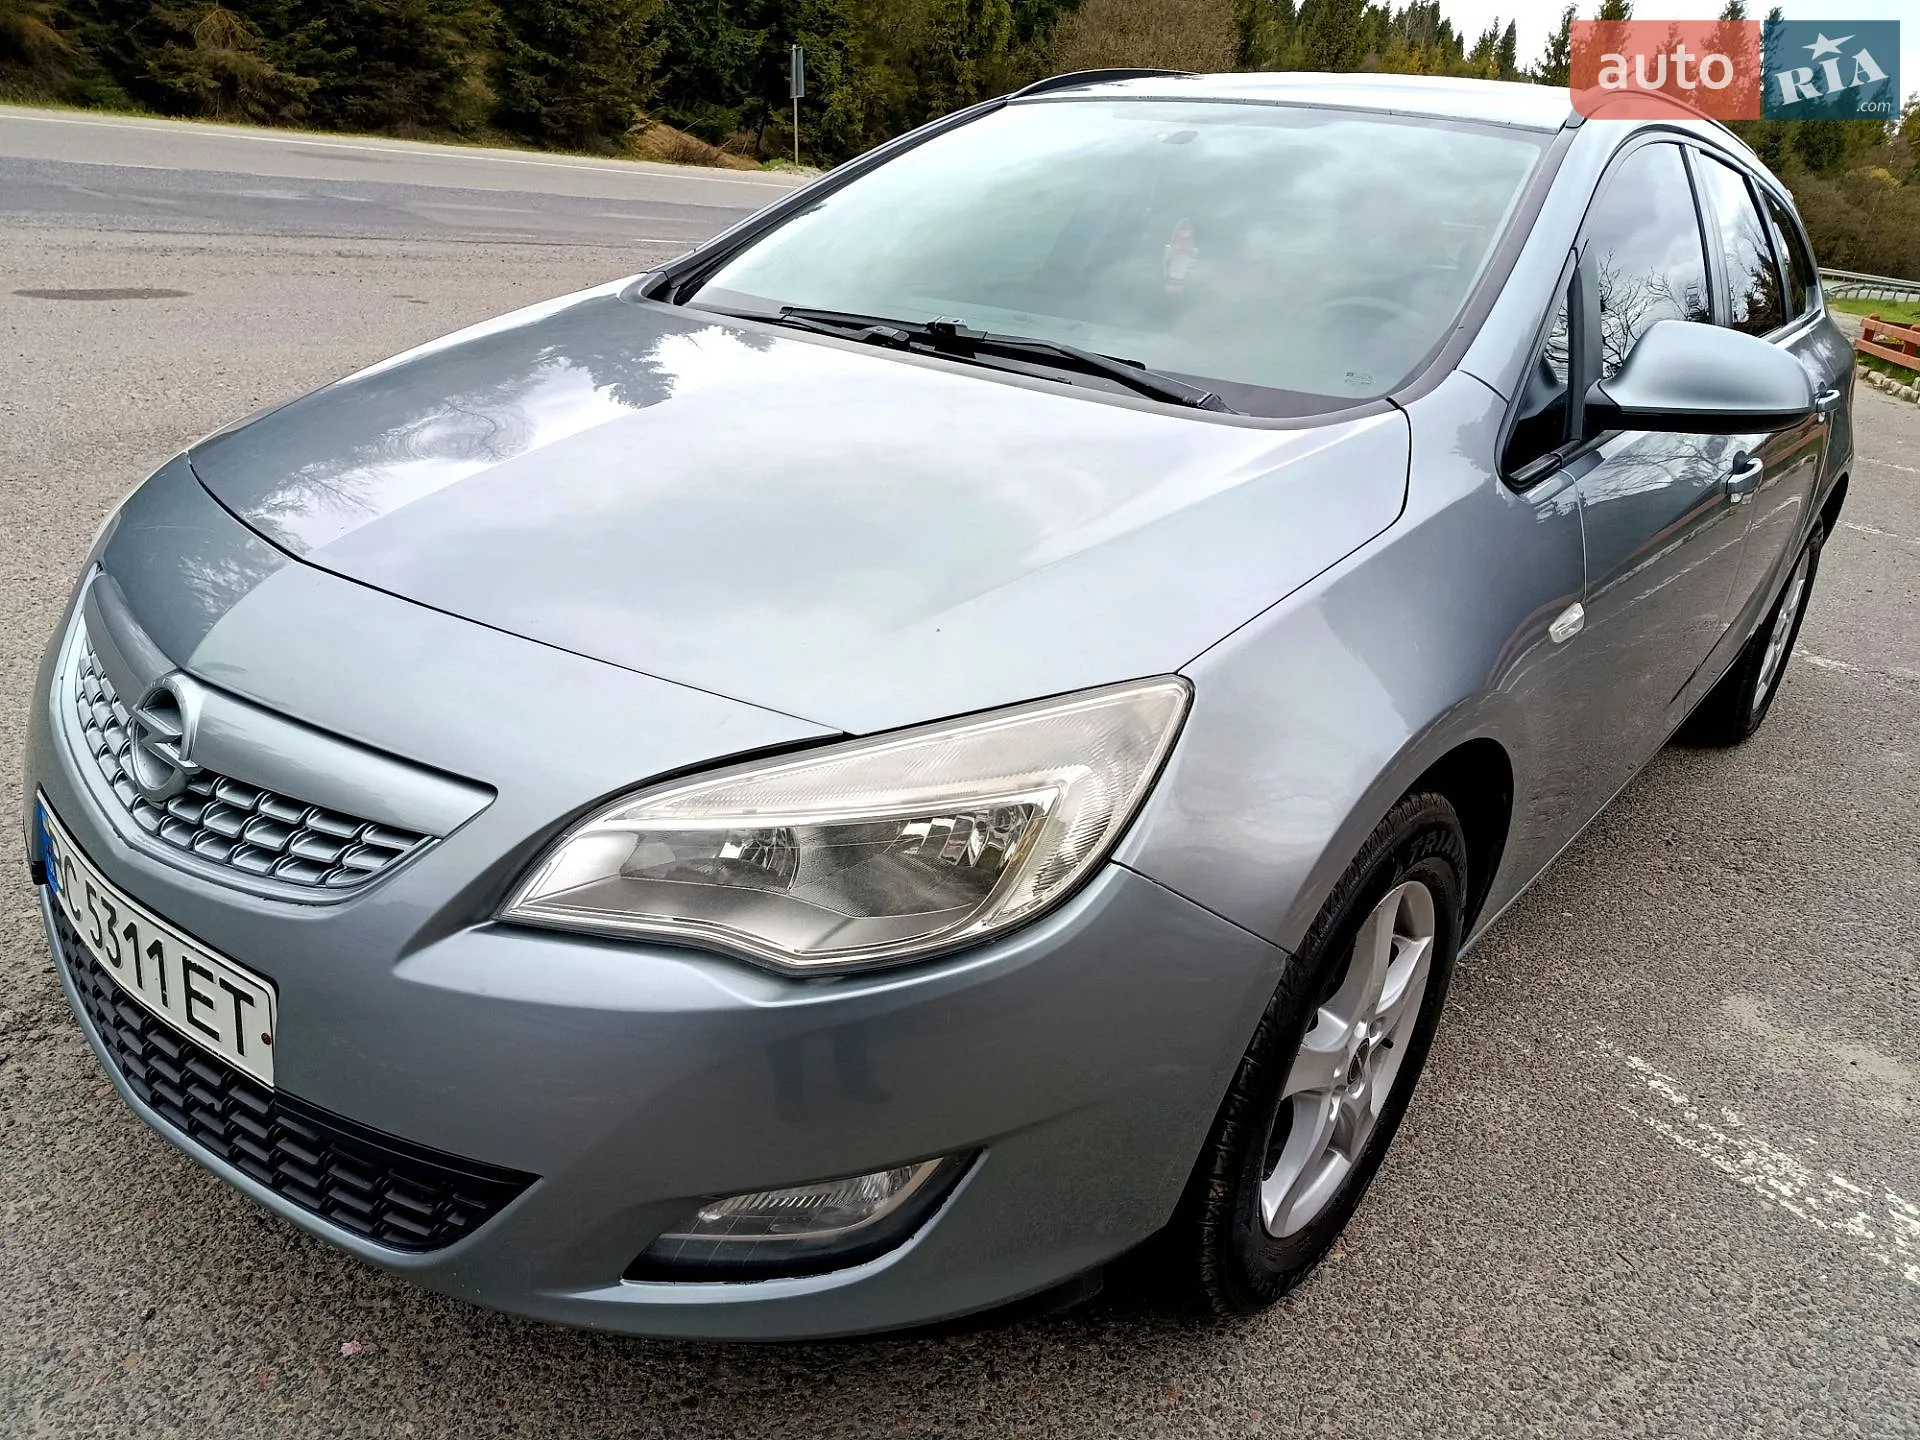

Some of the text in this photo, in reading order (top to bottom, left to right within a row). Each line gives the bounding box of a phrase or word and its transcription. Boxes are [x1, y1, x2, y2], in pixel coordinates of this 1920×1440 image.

[49, 828, 255, 1057] BC 5311 ET
